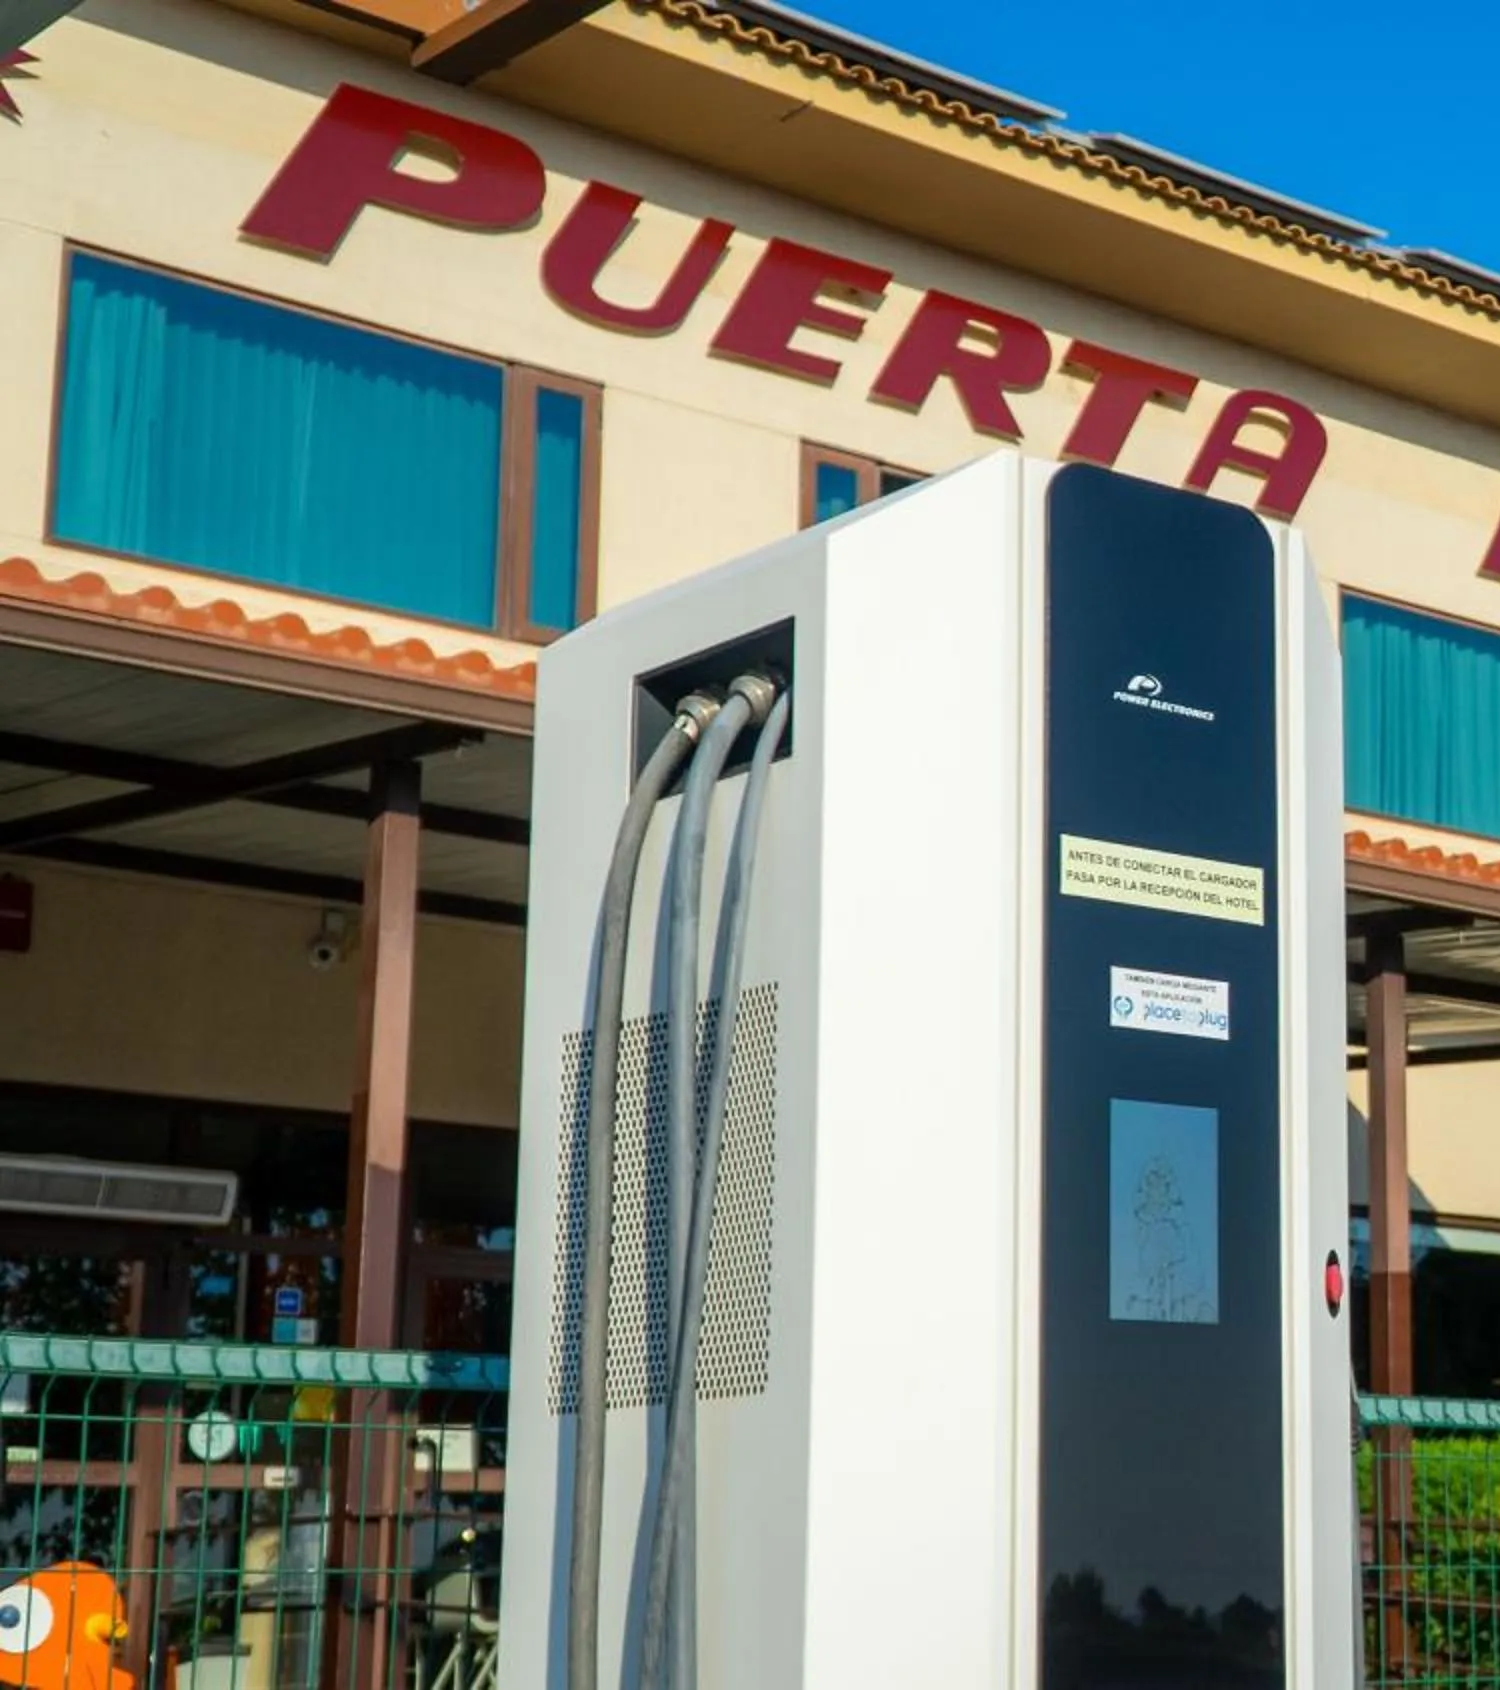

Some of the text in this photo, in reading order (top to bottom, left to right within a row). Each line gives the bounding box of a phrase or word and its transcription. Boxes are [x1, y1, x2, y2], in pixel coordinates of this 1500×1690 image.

[239, 82, 1328, 523] PUERTA
[1114, 691, 1214, 720] POWER ELECTRONICS
[1066, 869, 1095, 884] PASA
[1098, 875, 1121, 889] POR
[1124, 879, 1137, 891] LA
[1203, 892, 1222, 905] DEL
[1225, 896, 1260, 911] HOTEL
[1068, 849, 1257, 890] ANTES DE CONECTAR EL CARGADOR
